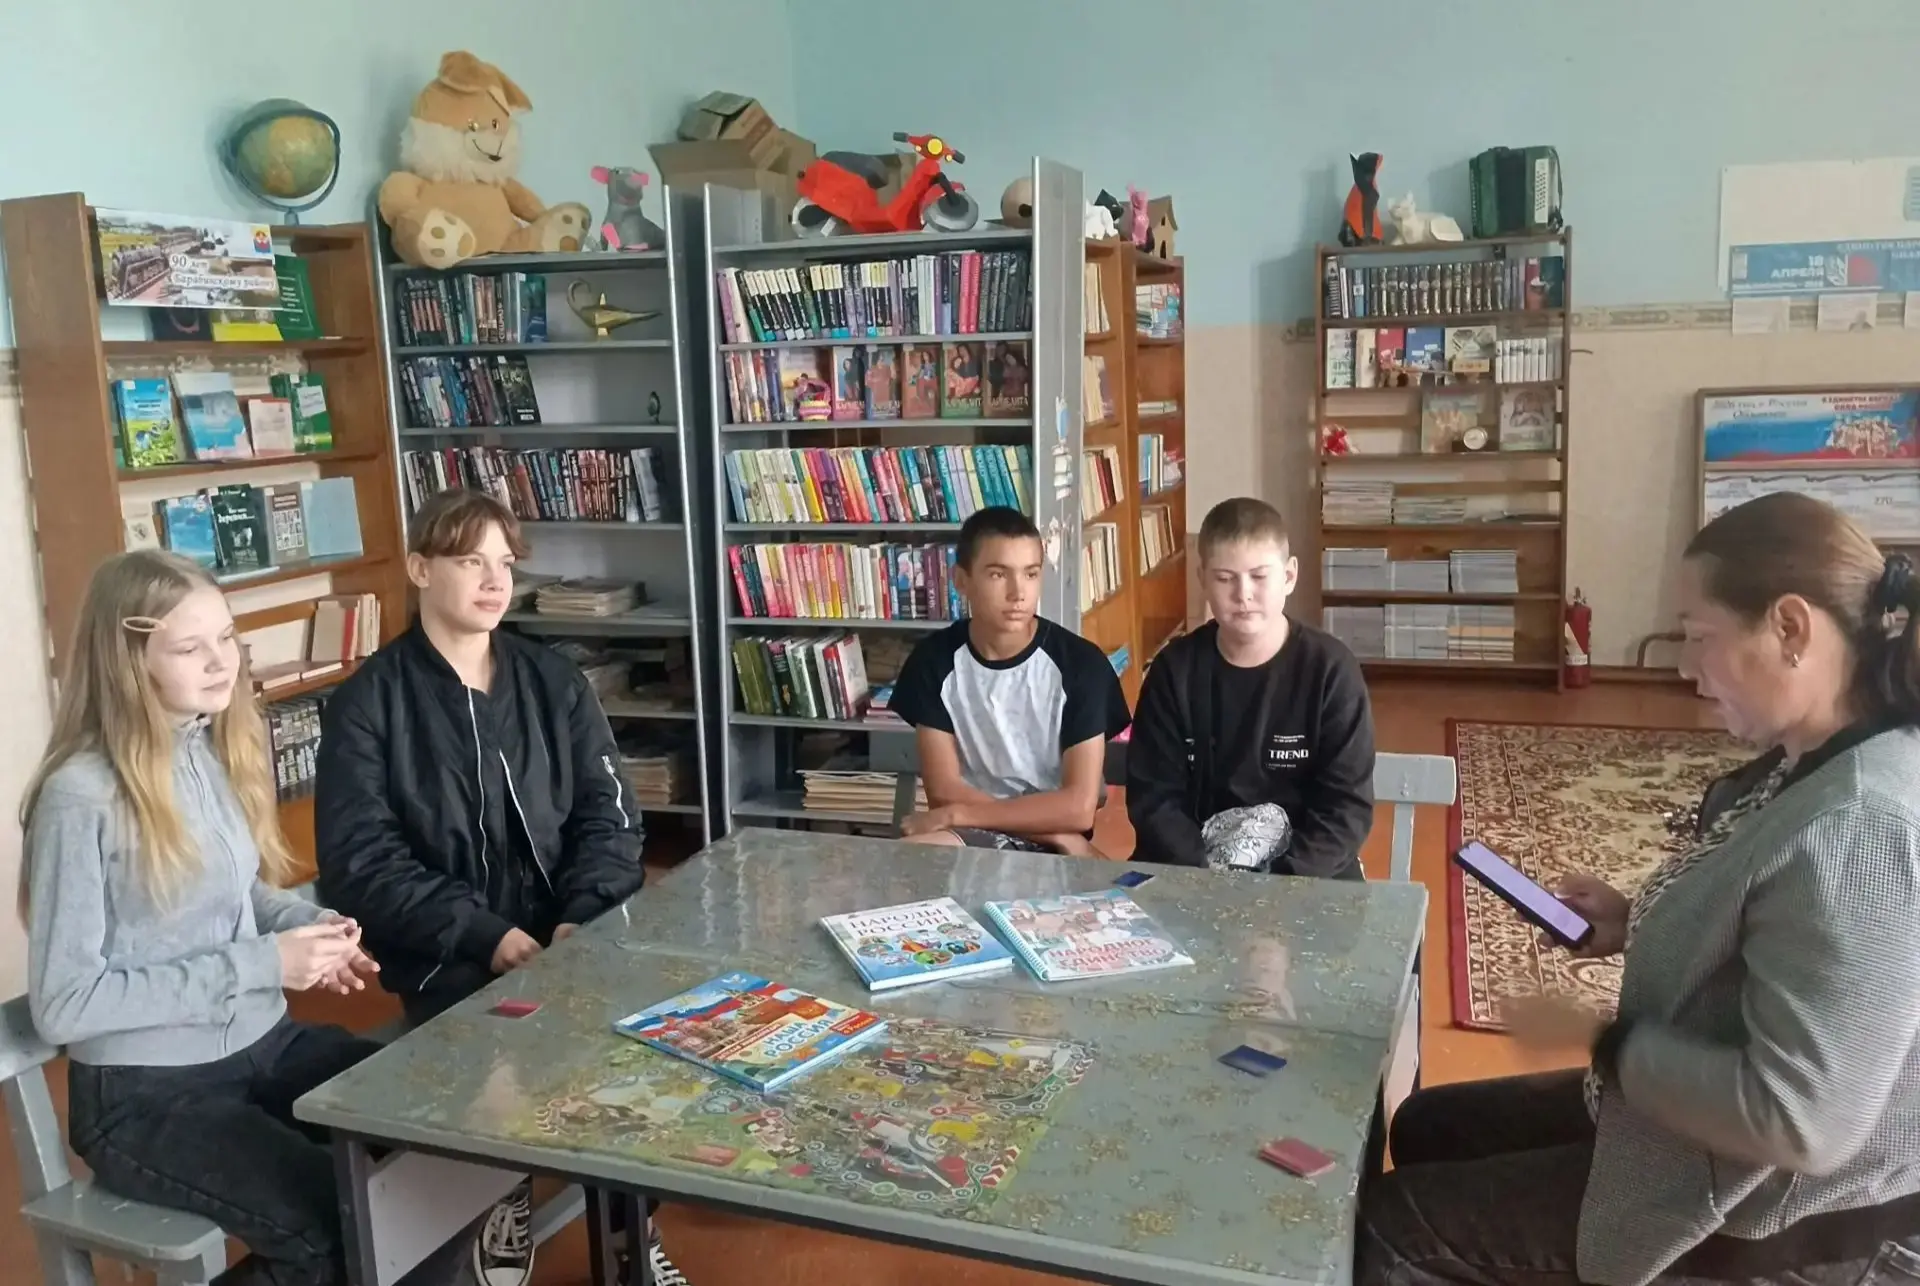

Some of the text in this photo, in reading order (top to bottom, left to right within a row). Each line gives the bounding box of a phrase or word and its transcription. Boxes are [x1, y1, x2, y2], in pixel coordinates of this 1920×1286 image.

[171, 255, 187, 268] 90
[1268, 749, 1309, 759] TREND
[849, 908, 945, 929] НАРОДЫ
[857, 915, 950, 936] РОССИИ
[1048, 938, 1154, 958] НАРОДНОЕ
[1058, 948, 1168, 968] ЕДИНСТВО
[763, 1021, 809, 1046] НАША
[764, 1018, 834, 1058] РОССИЯ
